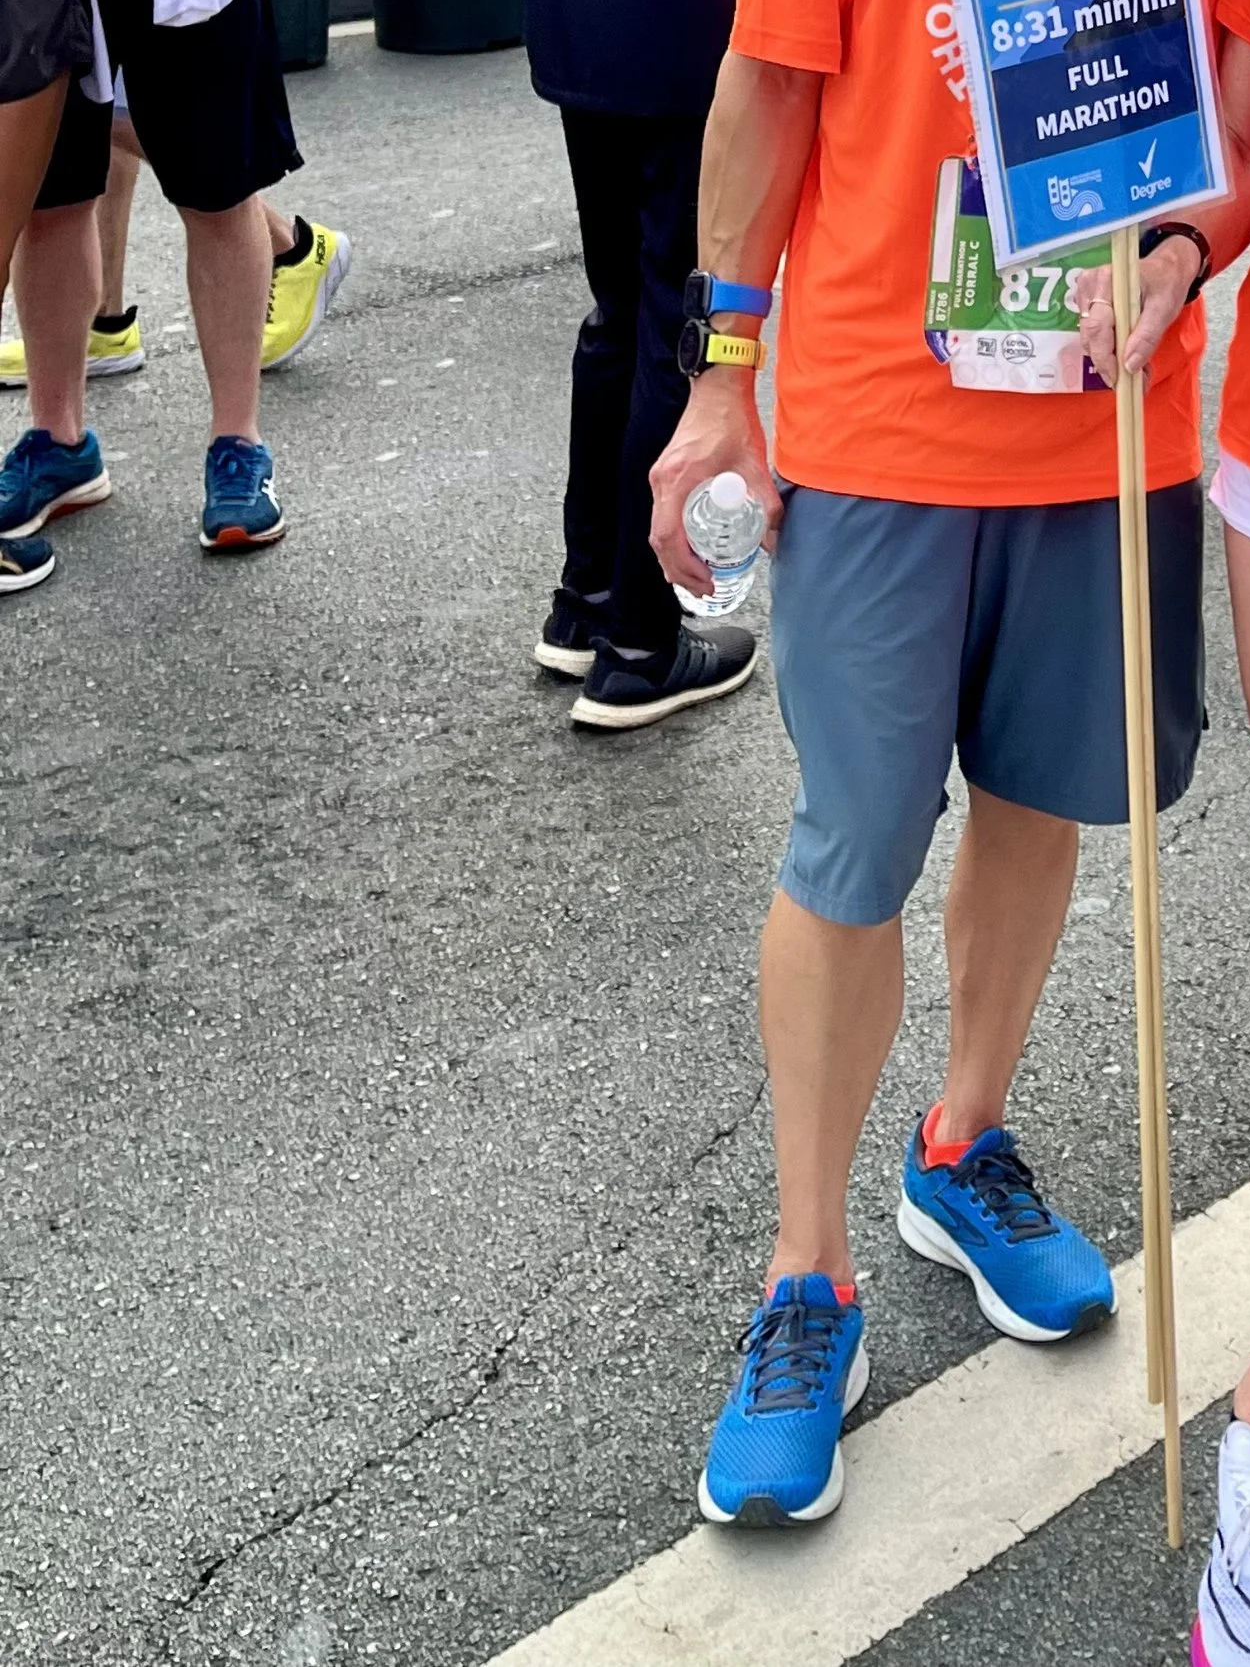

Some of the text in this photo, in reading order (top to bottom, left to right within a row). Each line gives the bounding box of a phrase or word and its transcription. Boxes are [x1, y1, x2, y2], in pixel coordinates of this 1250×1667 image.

[991, 5, 1068, 52] 8:31
[1067, 54, 1129, 91] FULL
[1035, 80, 1170, 140] MARATHON
[1130, 176, 1172, 201] Degree
[964, 240, 980, 307] CORRAL C
[1000, 267, 1085, 313] 878
[935, 292, 949, 322] 8786
